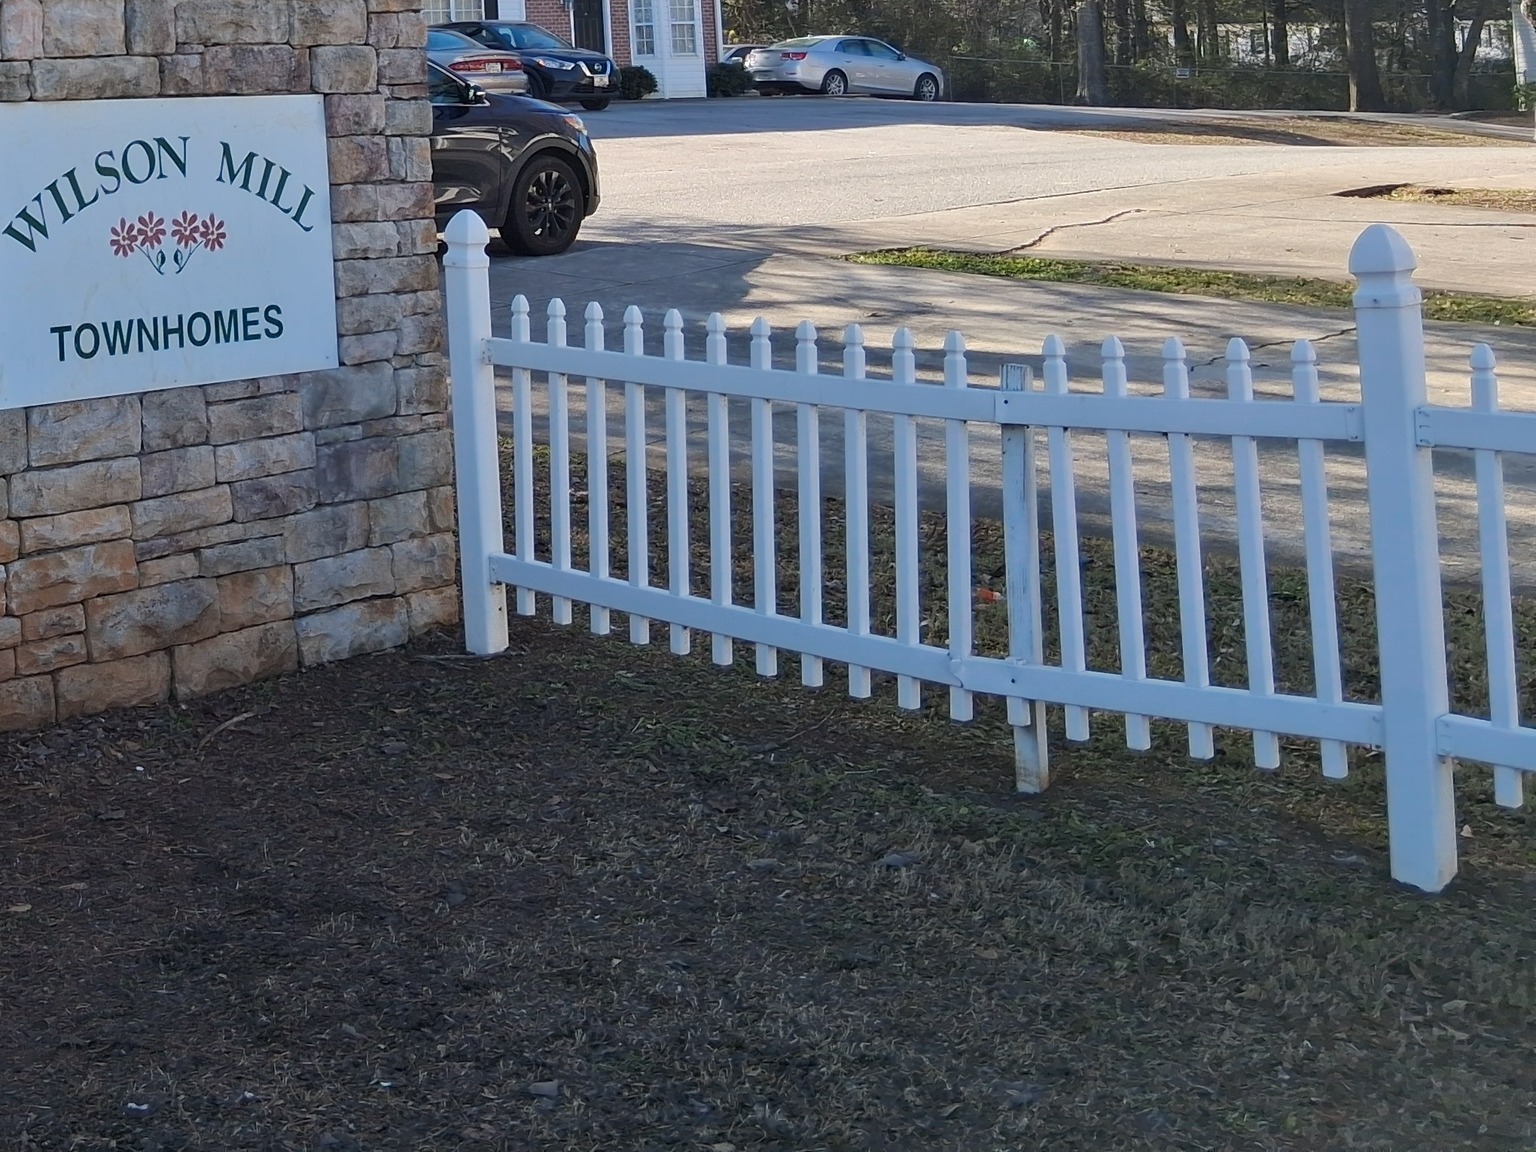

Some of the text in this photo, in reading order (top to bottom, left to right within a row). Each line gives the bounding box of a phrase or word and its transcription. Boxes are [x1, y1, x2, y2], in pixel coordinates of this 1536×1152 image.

[1, 135, 316, 253] WILSON MILL
[50, 304, 284, 362] TOWNHOMES
